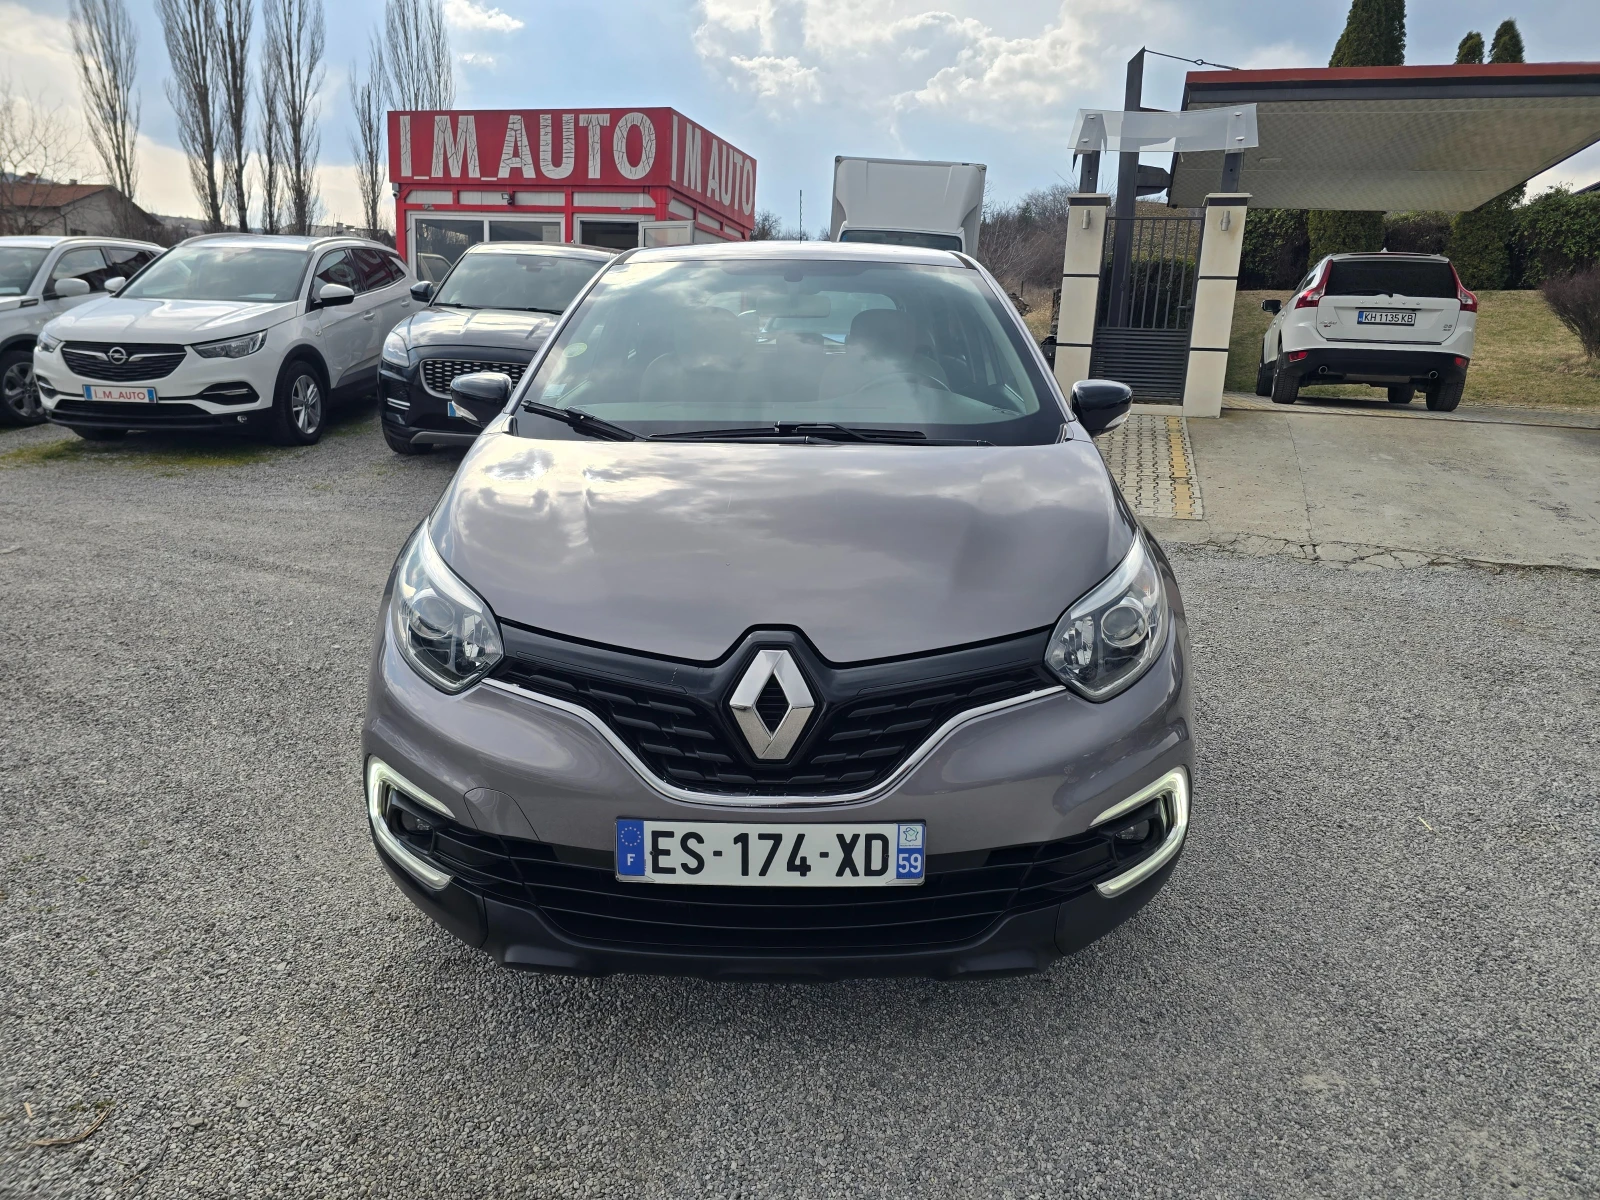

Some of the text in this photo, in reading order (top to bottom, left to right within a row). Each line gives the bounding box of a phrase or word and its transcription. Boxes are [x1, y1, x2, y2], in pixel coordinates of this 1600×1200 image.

[683, 122, 702, 193] M
[706, 138, 754, 216] AUTO
[1364, 312, 1377, 322] KH
[1379, 313, 1400, 322] 1135
[1400, 314, 1414, 323] KB
[626, 853, 636, 866] F
[651, 830, 890, 878] ES-174-XD
[898, 853, 922, 873] 59
